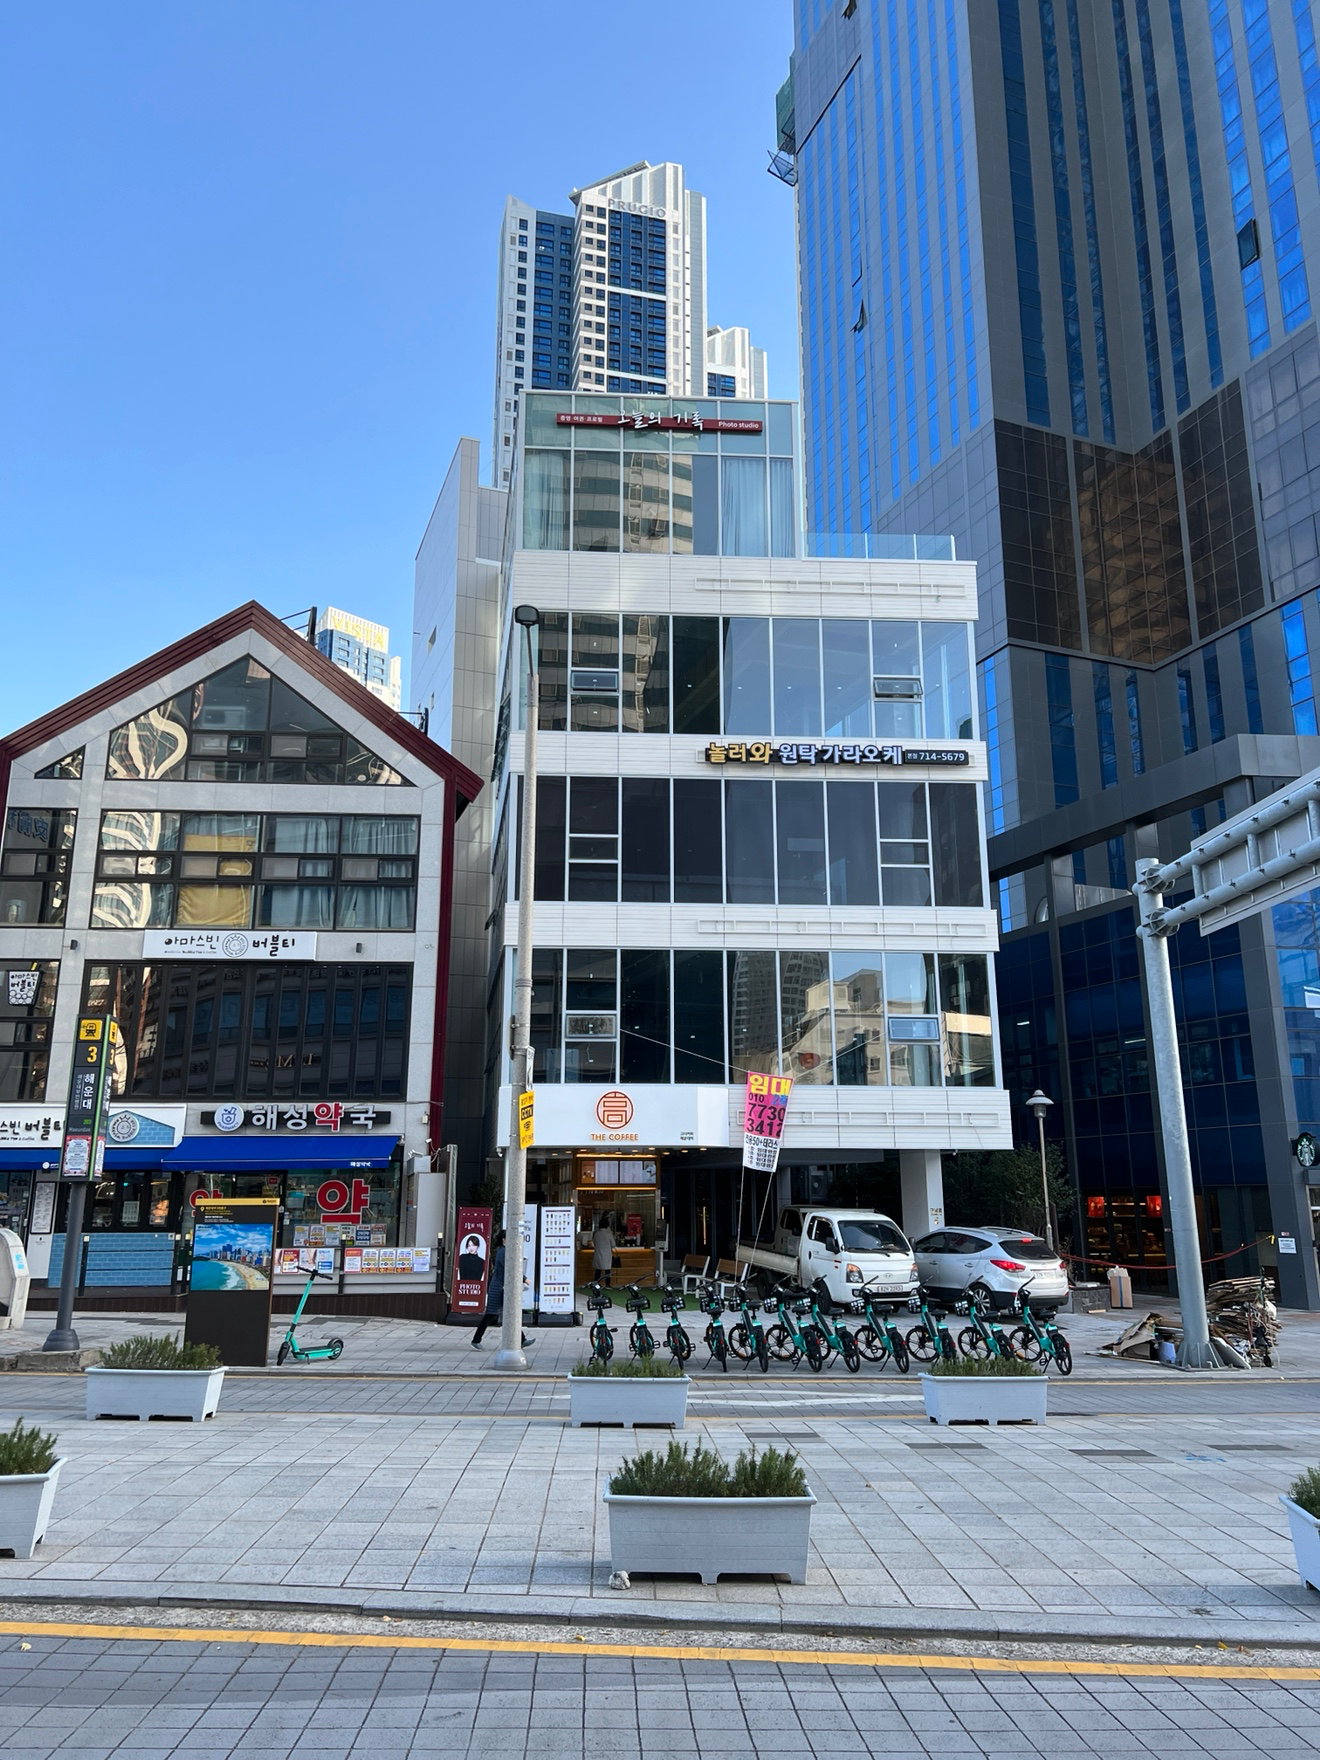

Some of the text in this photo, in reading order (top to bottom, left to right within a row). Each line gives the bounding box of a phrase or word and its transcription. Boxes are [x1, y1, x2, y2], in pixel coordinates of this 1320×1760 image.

[608, 198, 666, 218] PRUGIO
[739, 421, 759, 429] studio
[332, 615, 384, 648] VISTA
[708, 742, 773, 764] 놀러와
[919, 752, 965, 761] 714-5679
[164, 935, 219, 950] 아마스빈
[252, 934, 295, 957] 버블티
[87, 1046, 98, 1063] 3
[82, 1073, 95, 1110] 해운대
[749, 1074, 792, 1096] 임대
[748, 1092, 765, 1103] 010
[251, 1101, 377, 1132] 해성약국
[748, 1102, 786, 1122] 7730
[590, 1133, 639, 1141] THE COFFEE
[746, 1118, 783, 1137] 3412
[316, 1178, 371, 1225] 약
